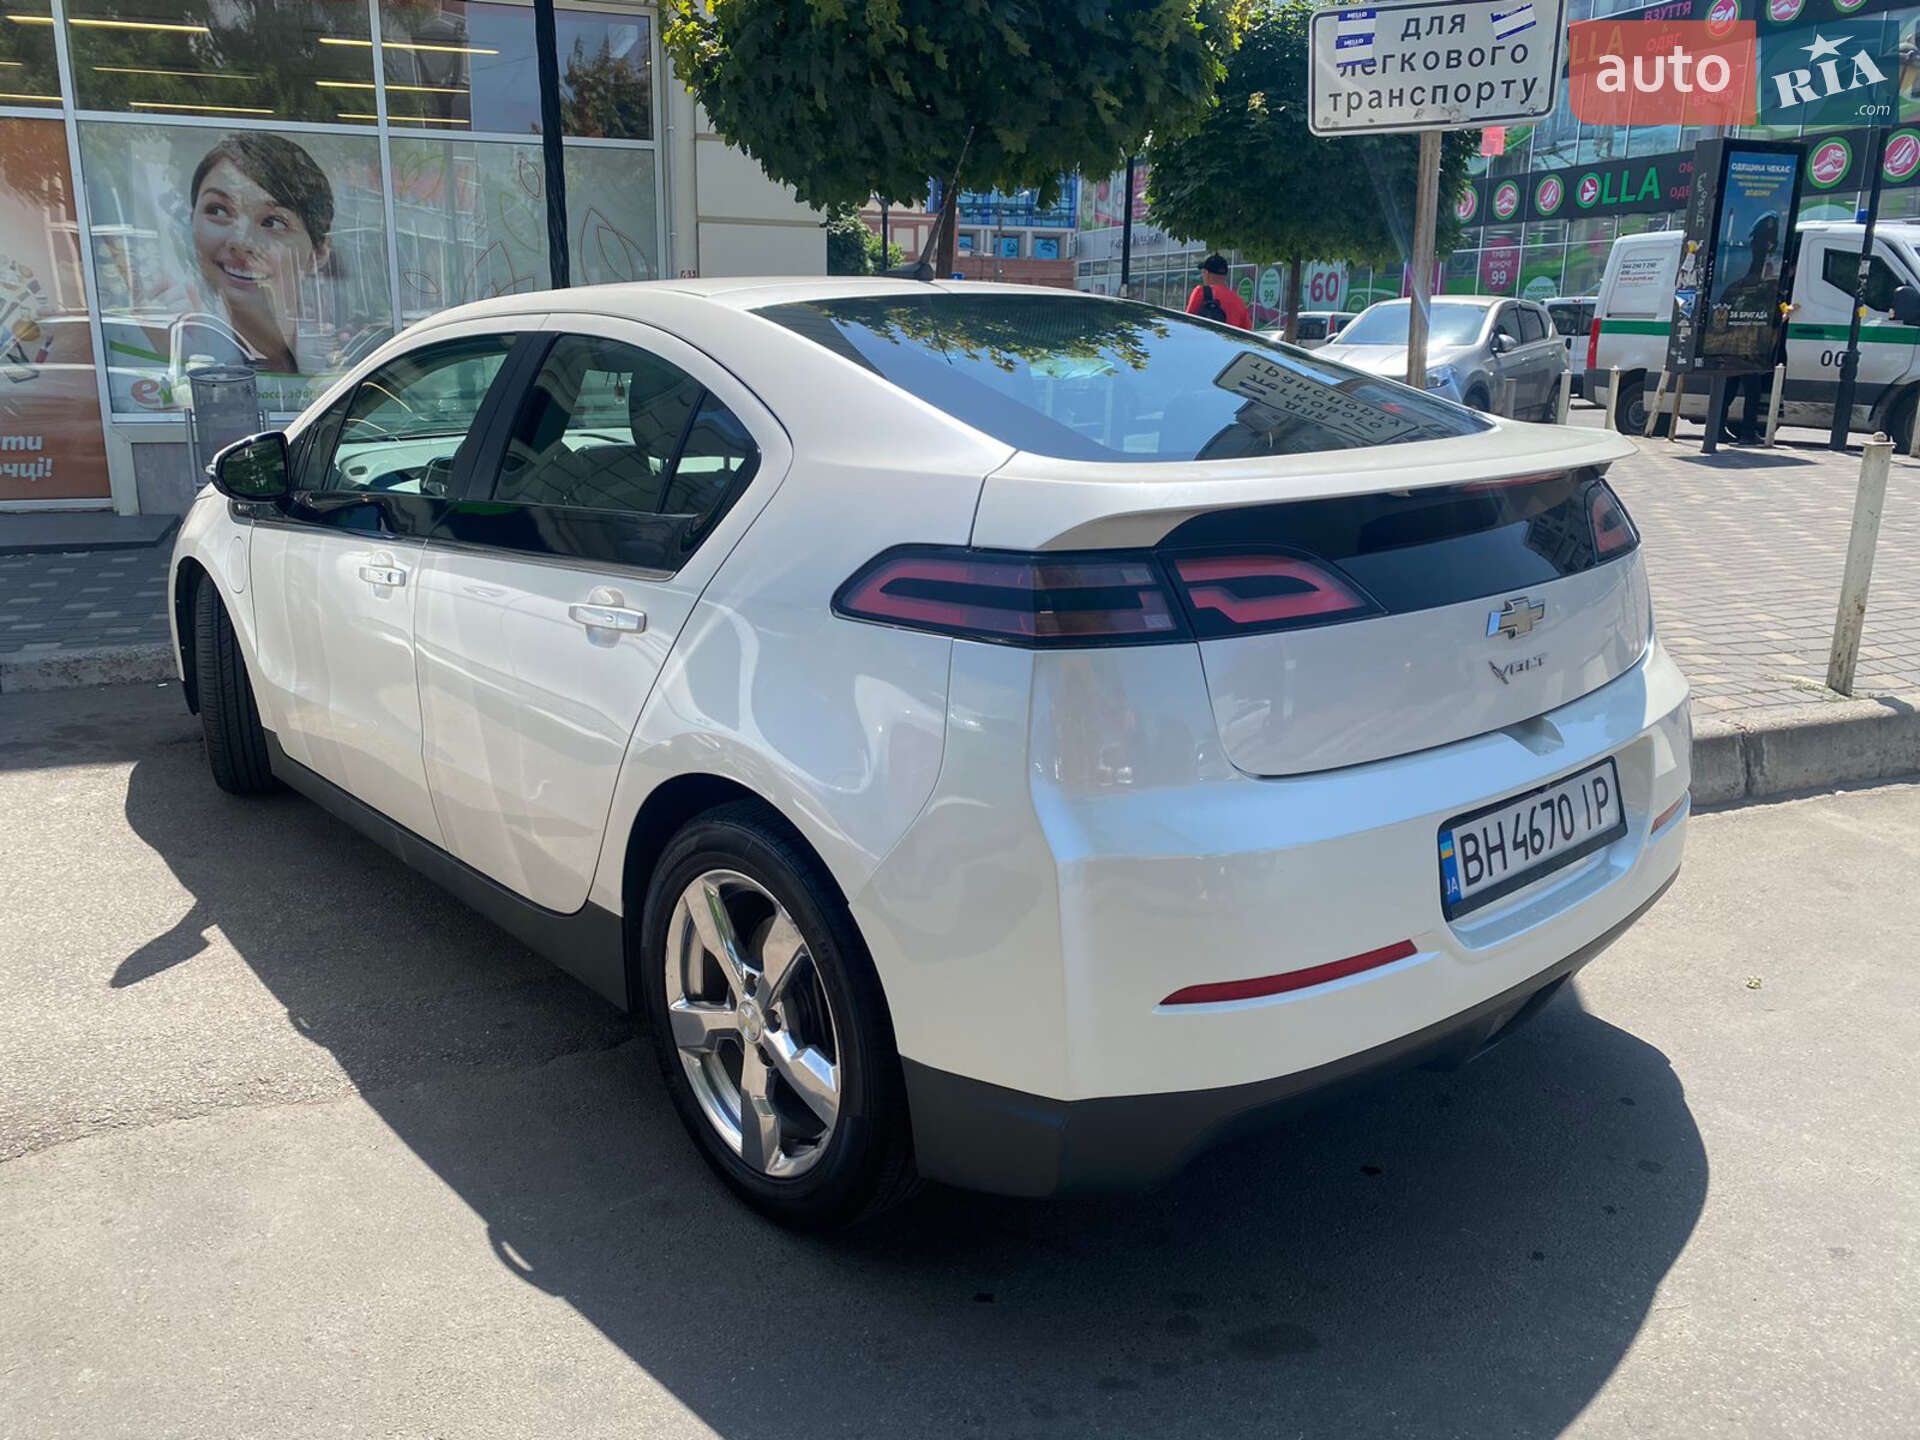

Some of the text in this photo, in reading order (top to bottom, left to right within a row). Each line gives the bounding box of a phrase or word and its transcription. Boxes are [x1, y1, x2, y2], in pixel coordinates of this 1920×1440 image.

[1400, 13, 1466, 41] для
[1340, 42, 1529, 77] легкового
[1328, 76, 1538, 118] транспорту
[1491, 270, 1507, 285] 99
[1, 435, 42, 451] ти
[0, 456, 53, 482] чці!
[1488, 655, 1546, 685] VOLT
[1460, 775, 1610, 888] BH 4670 IP
